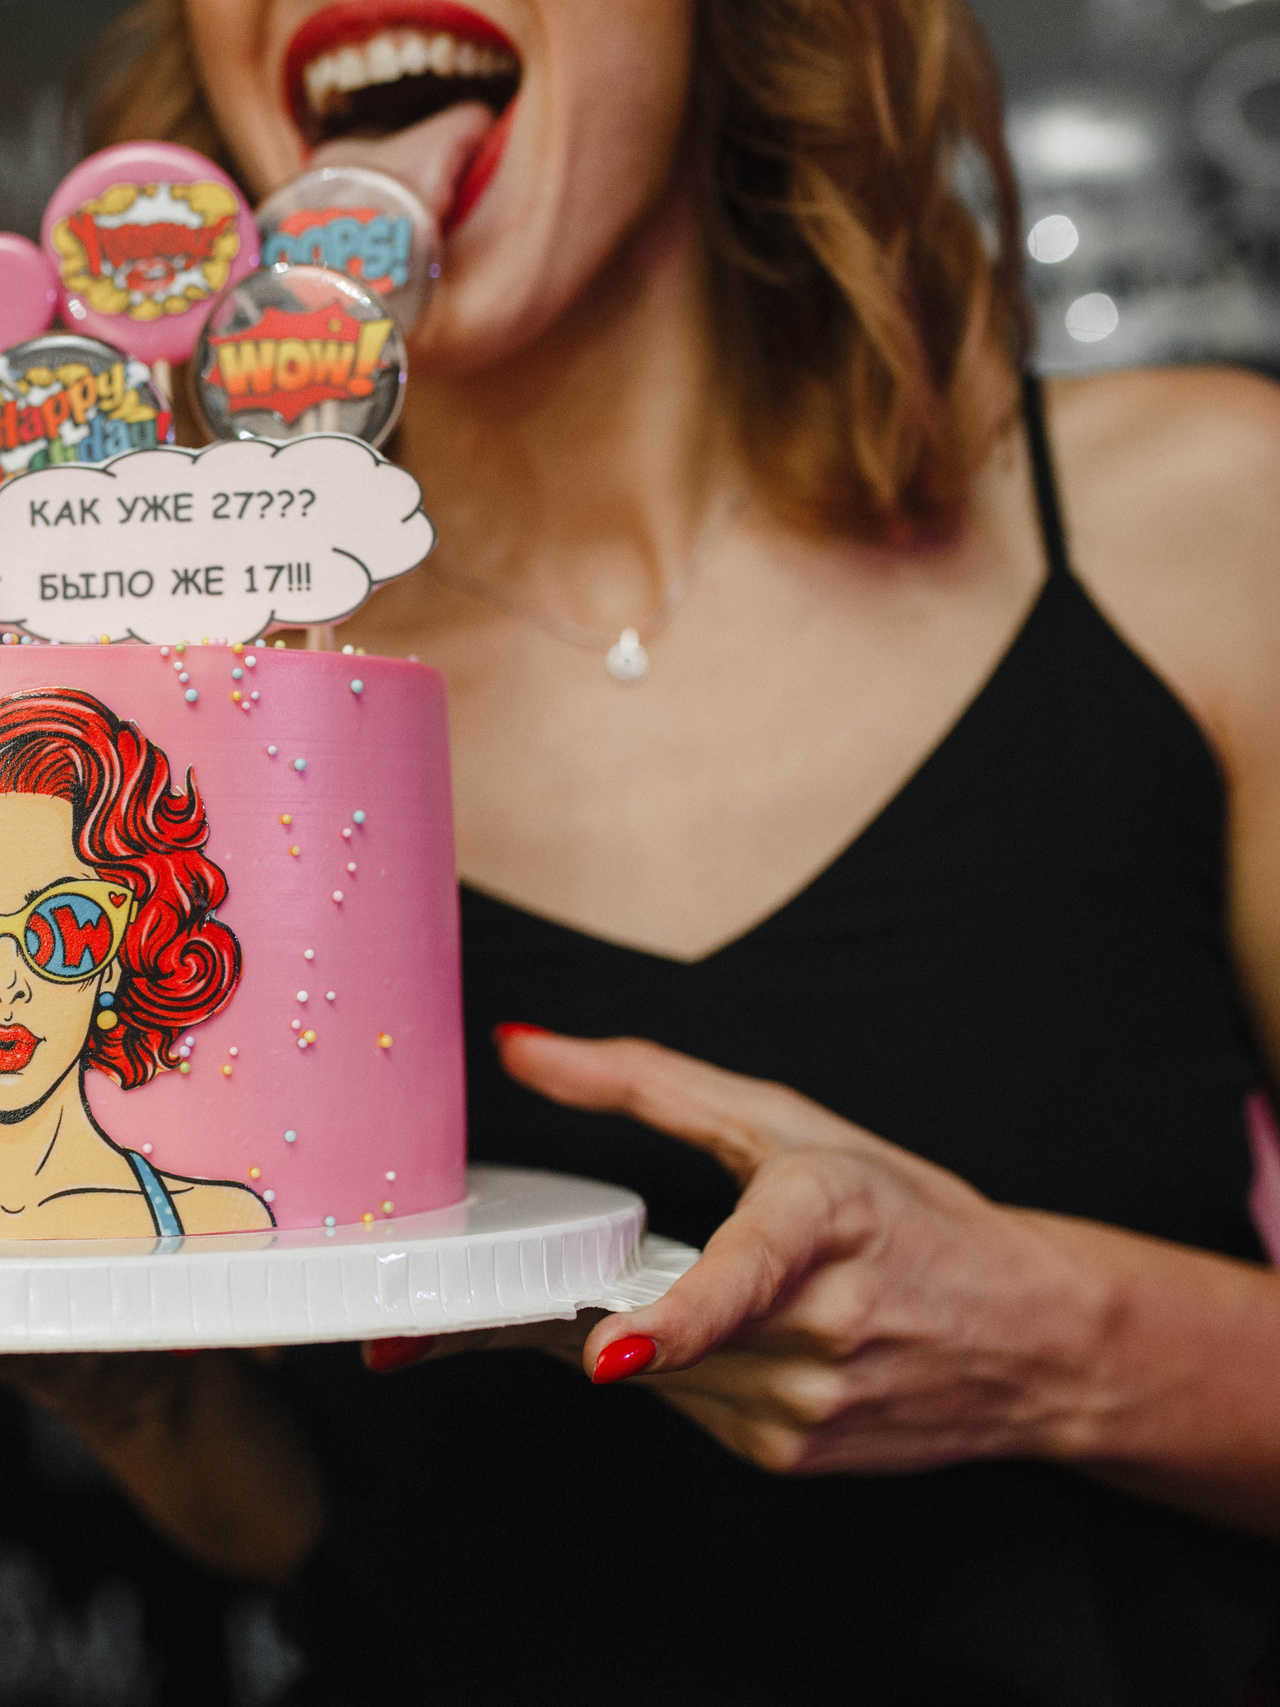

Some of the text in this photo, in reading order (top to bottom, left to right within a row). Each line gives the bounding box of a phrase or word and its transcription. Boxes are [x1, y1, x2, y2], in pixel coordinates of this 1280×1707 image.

[218, 320, 394, 397] WOW!
[29, 489, 316, 527] КАК УЖЕ 27???
[40, 562, 312, 600] БЫЛО ЖЕ 17!!!
